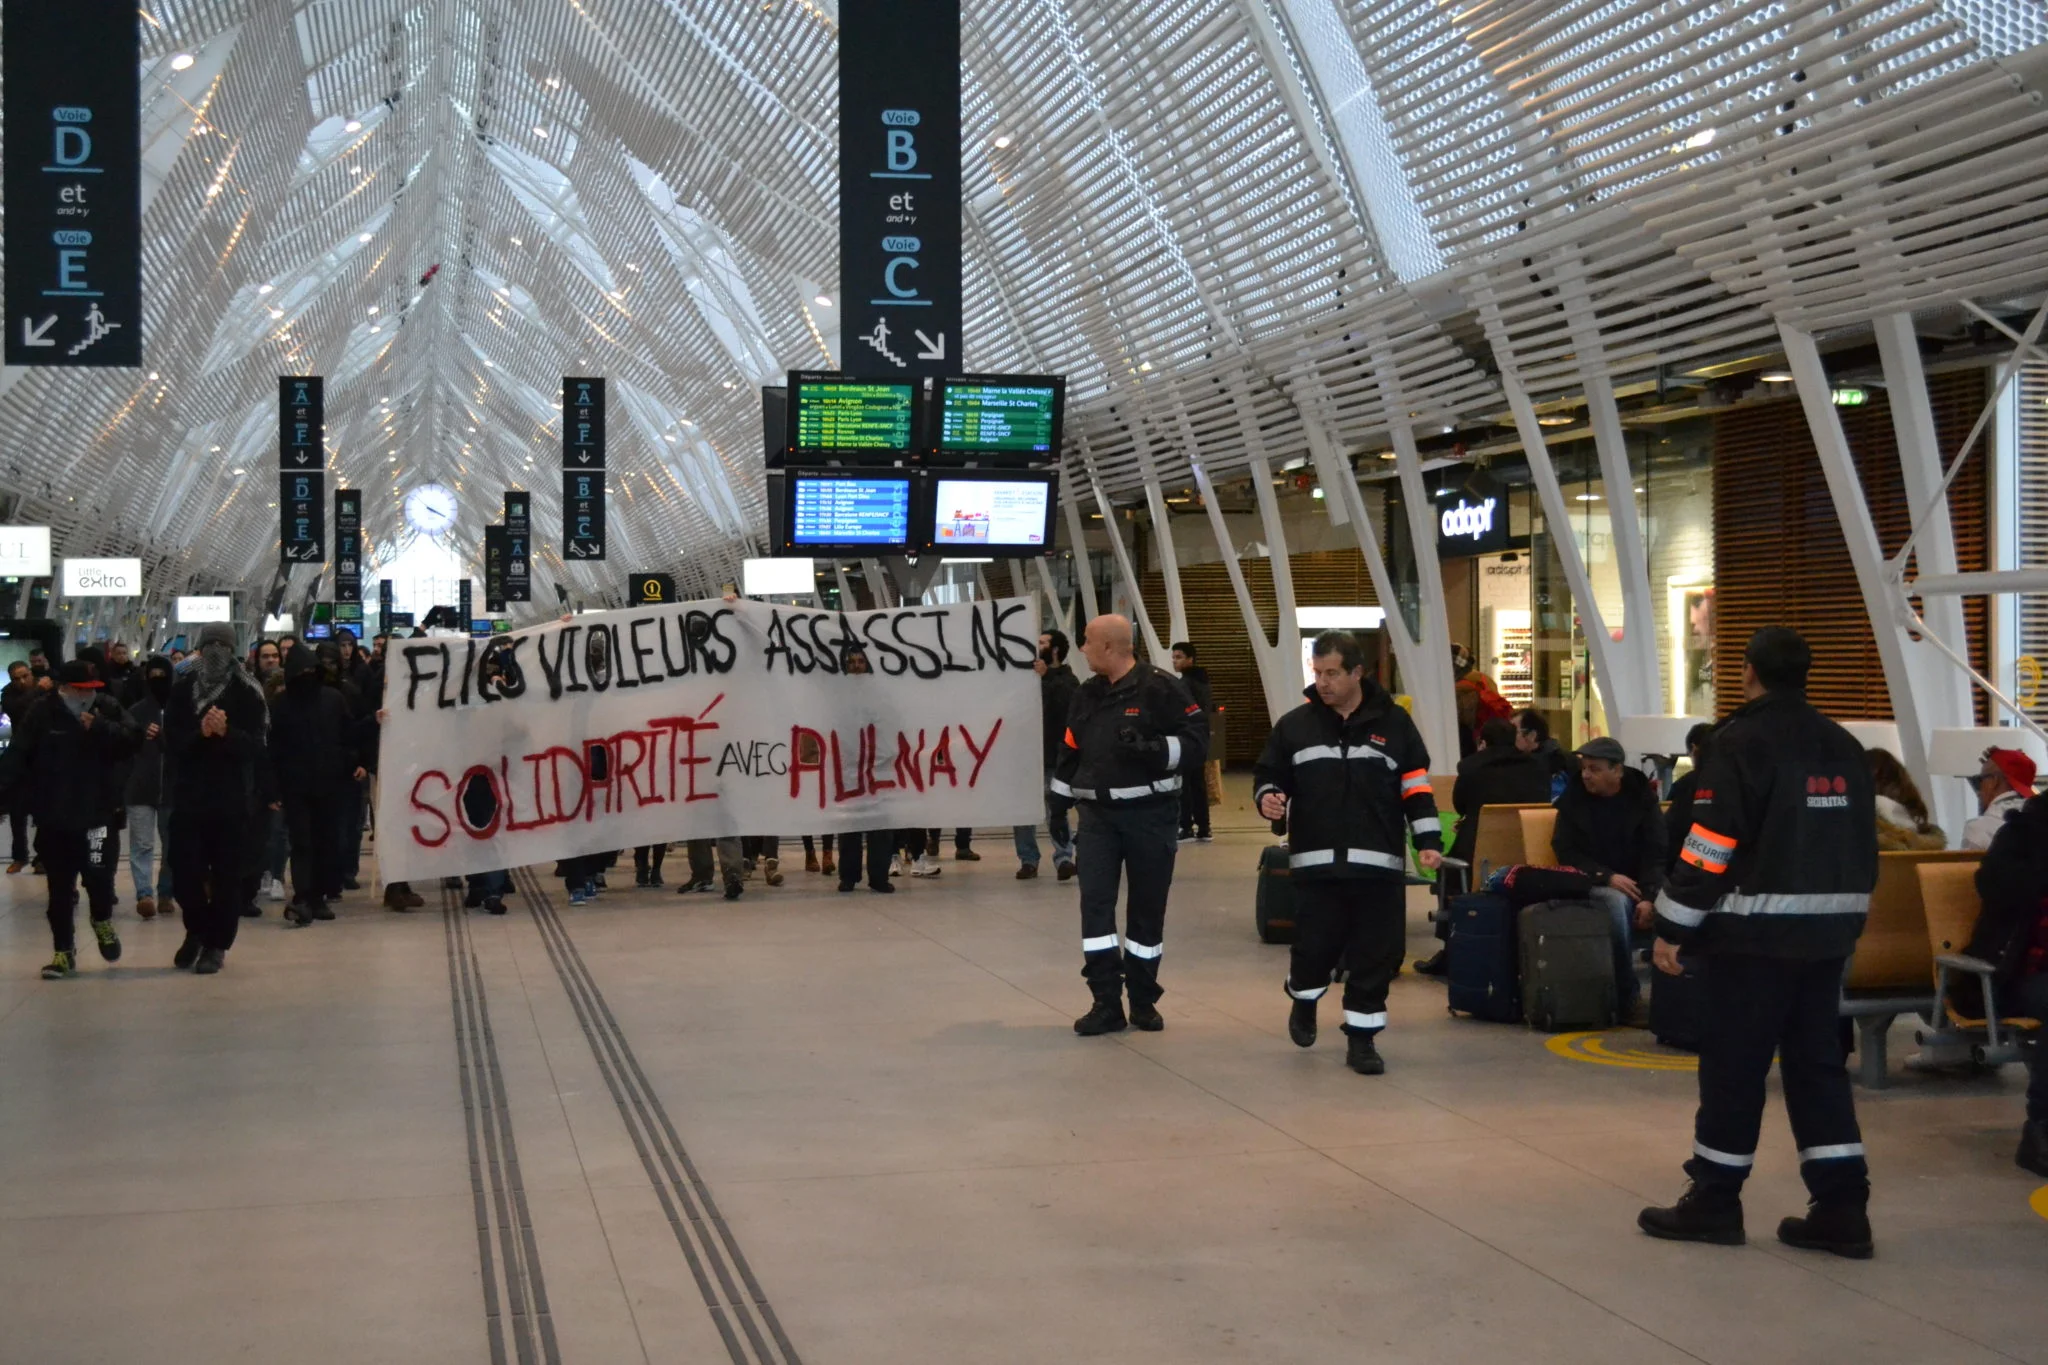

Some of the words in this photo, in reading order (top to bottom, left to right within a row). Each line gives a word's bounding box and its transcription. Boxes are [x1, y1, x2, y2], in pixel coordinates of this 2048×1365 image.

[58, 109, 87, 121] Voie
[886, 112, 915, 124] Voie
[56, 126, 91, 165] D
[887, 130, 917, 171] B
[60, 184, 86, 203] et
[889, 192, 914, 211] et
[59, 233, 87, 244] Voie
[888, 238, 915, 250] Voie
[60, 250, 88, 289] E
[885, 257, 919, 298] C
[296, 389, 308, 403] A
[579, 390, 590, 403] A
[298, 429, 307, 442] F
[581, 429, 589, 442] F
[296, 484, 309, 498] D
[580, 483, 589, 496] B
[298, 525, 308, 539] E
[579, 523, 590, 536] C
[79, 574, 126, 588] extra
[537, 608, 737, 700] VIOLEURS
[765, 604, 1039, 678] ASSASSINS
[410, 693, 724, 848] SOLIDARITÉ
[717, 740, 787, 778] AVEC
[789, 717, 1003, 809] AULNAY
